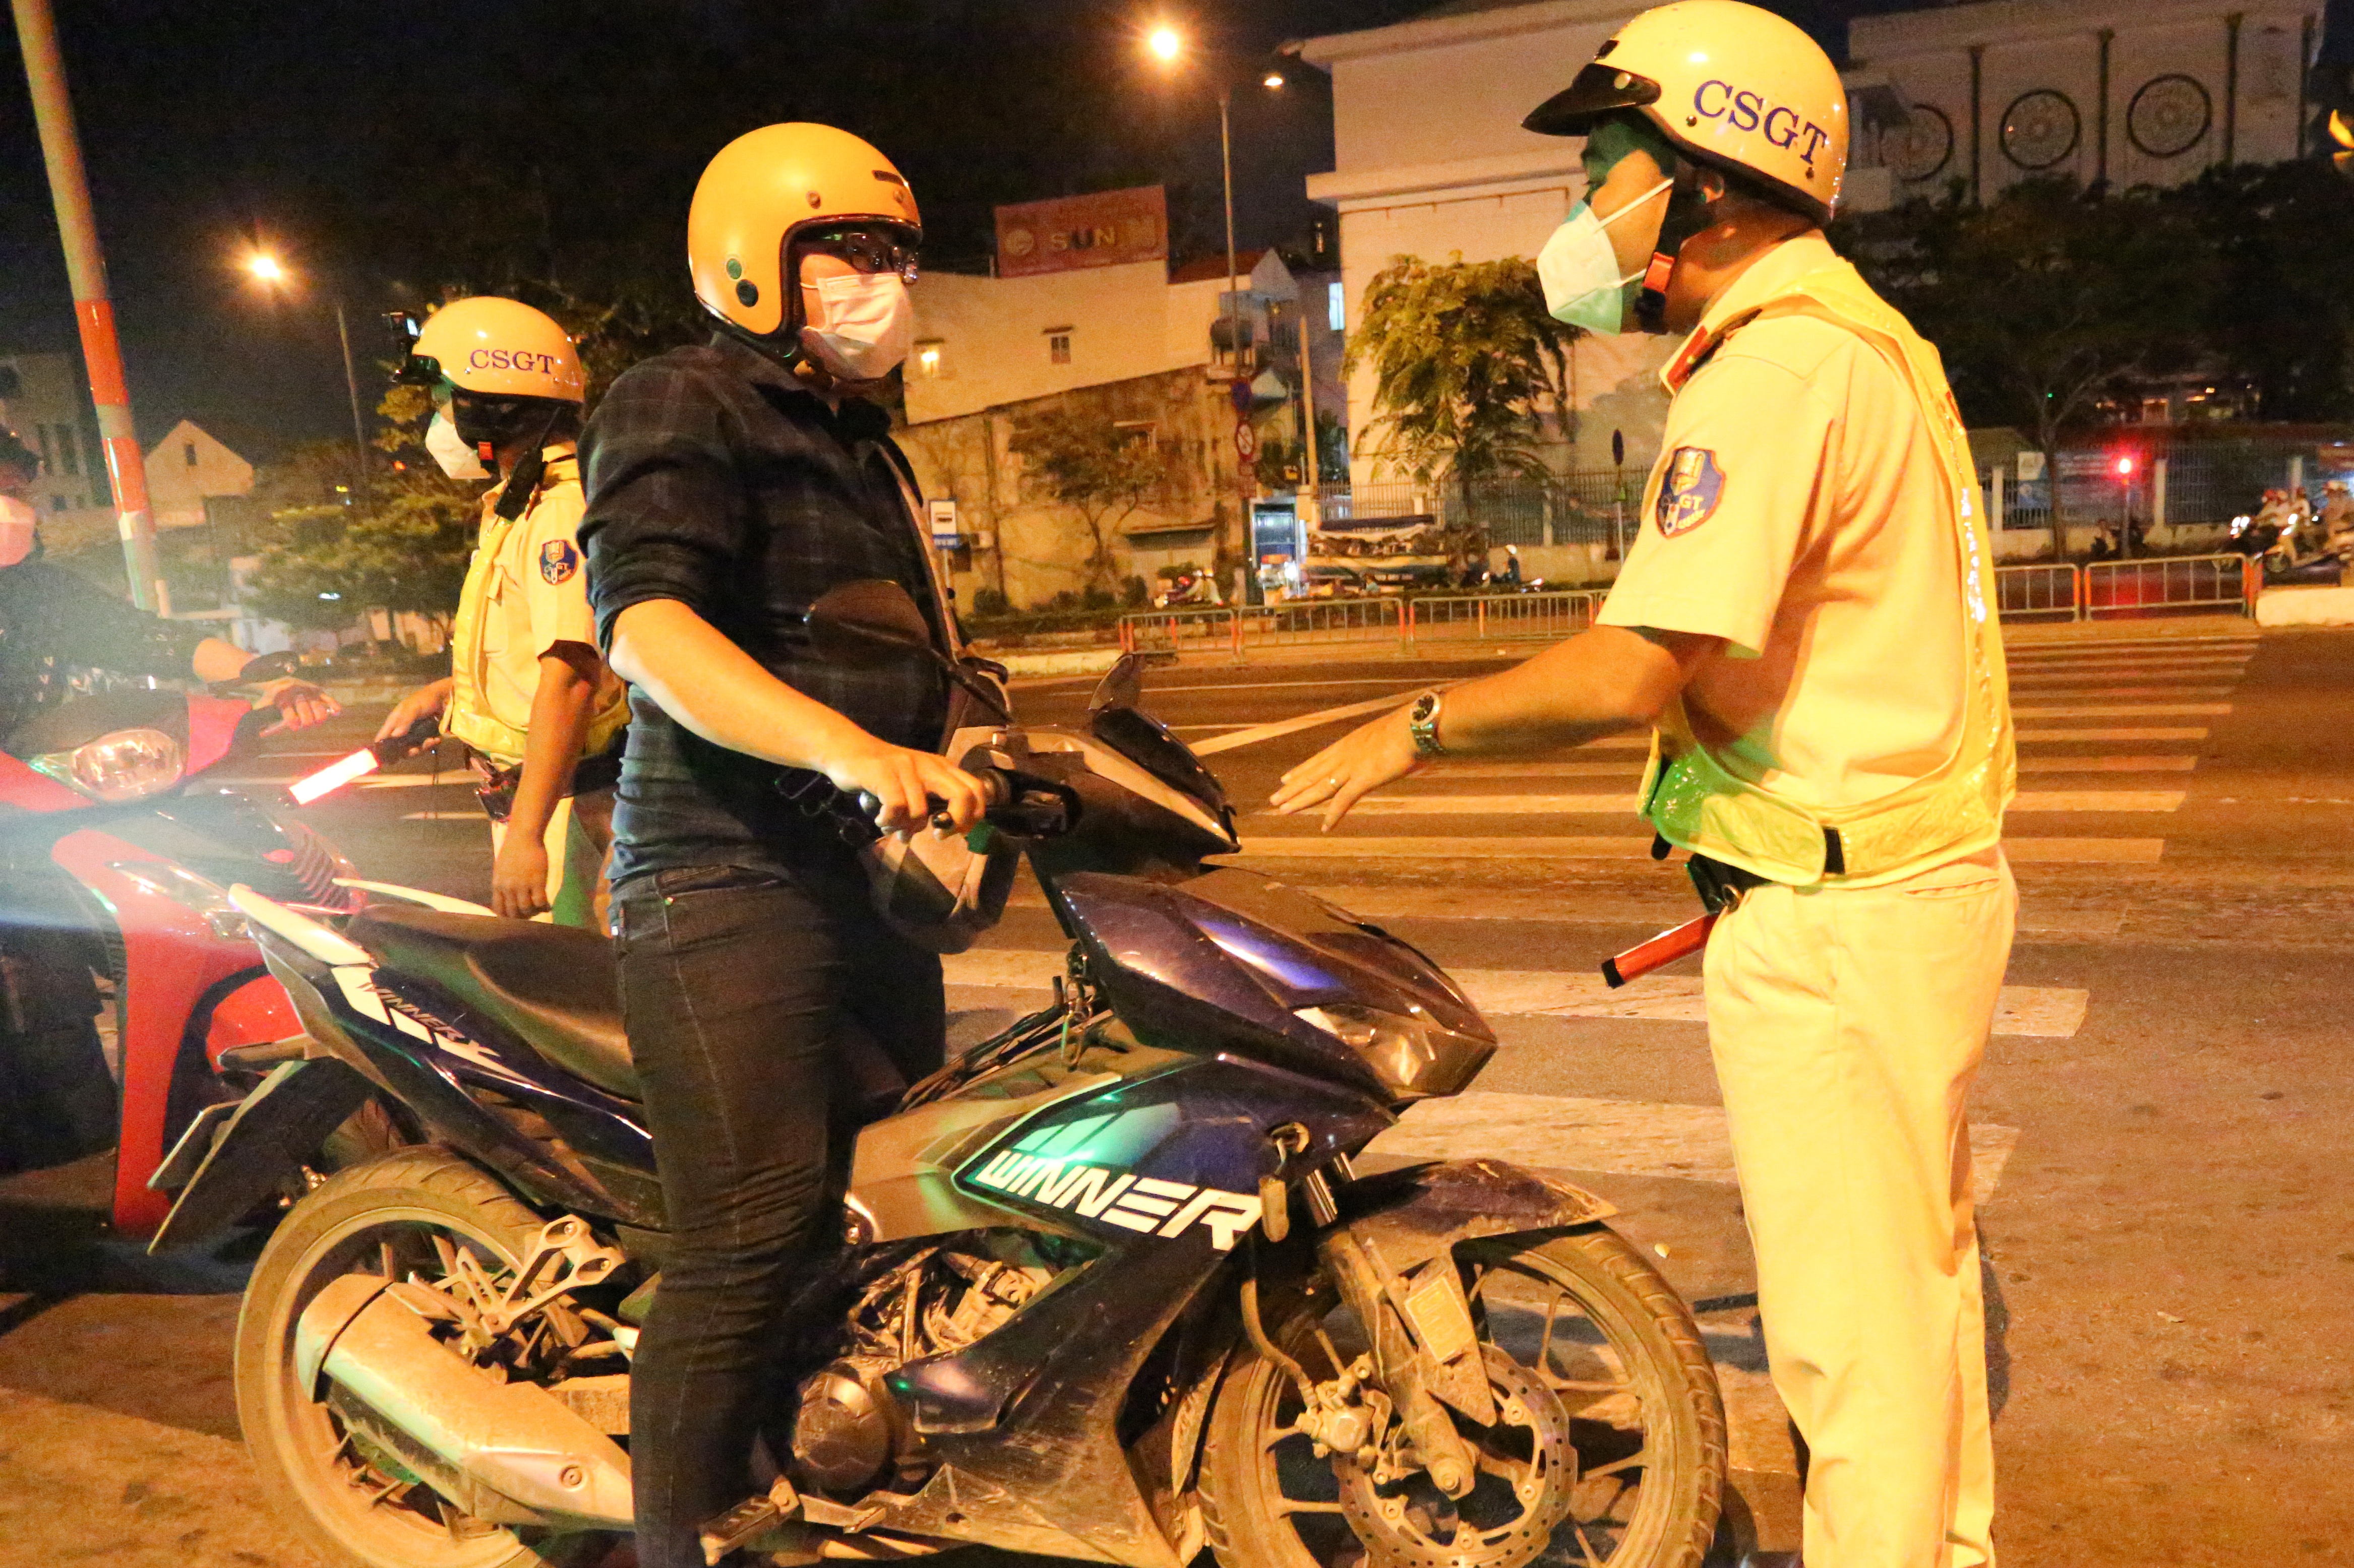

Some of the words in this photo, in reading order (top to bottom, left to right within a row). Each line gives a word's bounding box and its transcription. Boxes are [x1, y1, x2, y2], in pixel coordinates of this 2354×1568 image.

[1694, 79, 1828, 166] CSGT
[1050, 226, 1116, 250] SUN
[470, 349, 554, 374] CSGT
[356, 982, 465, 1041] WINNER
[976, 1150, 1262, 1251] WINNER
